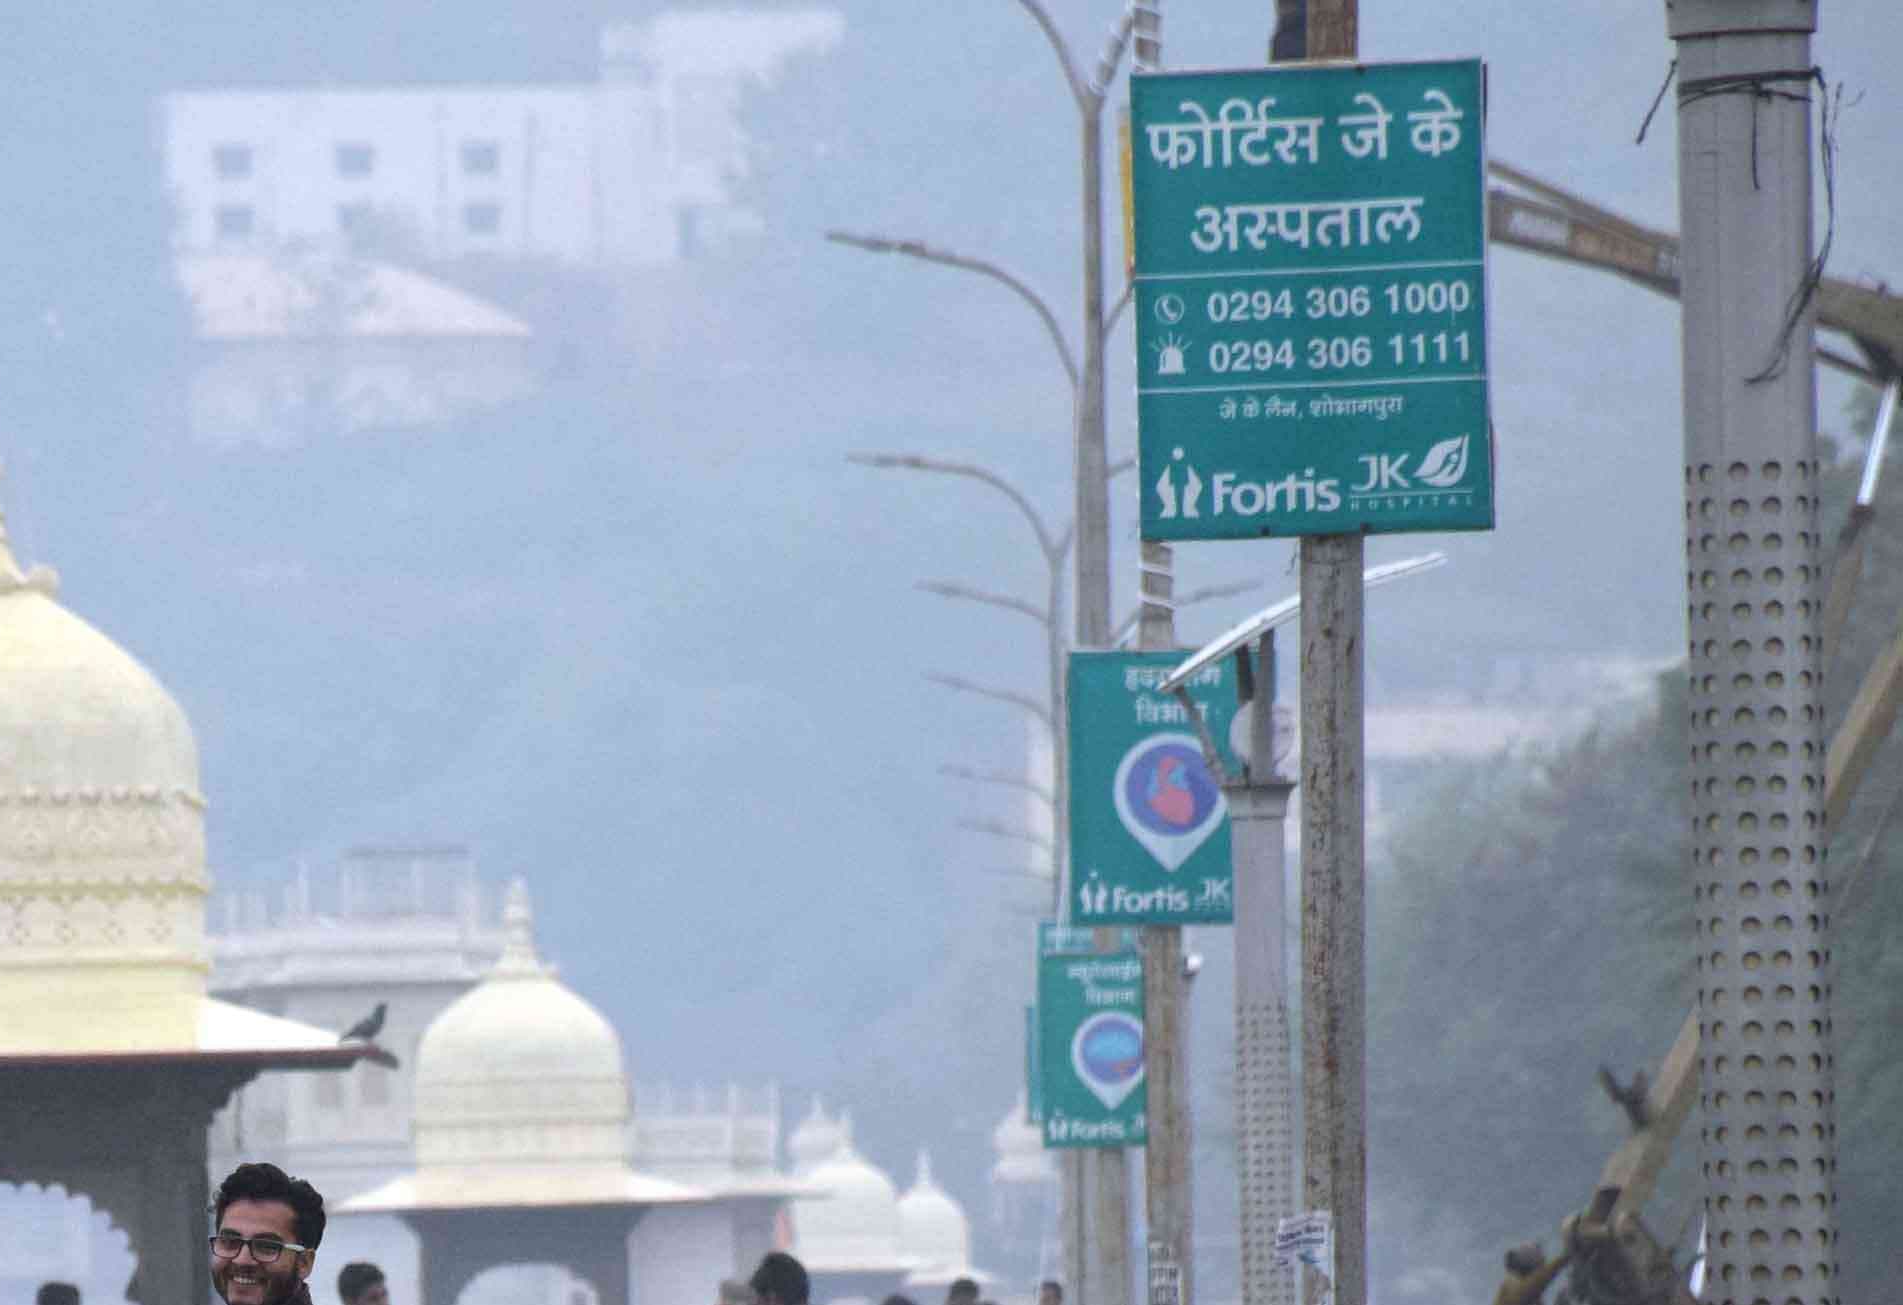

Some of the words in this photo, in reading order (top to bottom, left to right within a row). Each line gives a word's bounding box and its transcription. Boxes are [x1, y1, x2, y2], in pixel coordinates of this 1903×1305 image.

[1146, 97, 1325, 169] फोर्टिस
[1338, 92, 1393, 160] जे
[1407, 89, 1464, 158] के
[1190, 196, 1425, 253] अस्पताल
[1206, 288, 1294, 323] 0294
[1305, 285, 1371, 319] 306
[1384, 280, 1470, 314] 1000
[1208, 338, 1295, 373] 0294
[1307, 335, 1373, 369] 306
[1388, 331, 1471, 365] 1111
[1212, 466, 1342, 517] Fortis
[1350, 453, 1412, 493] JK
[1113, 883, 1189, 913] Fortis
[1197, 879, 1231, 902] JK
